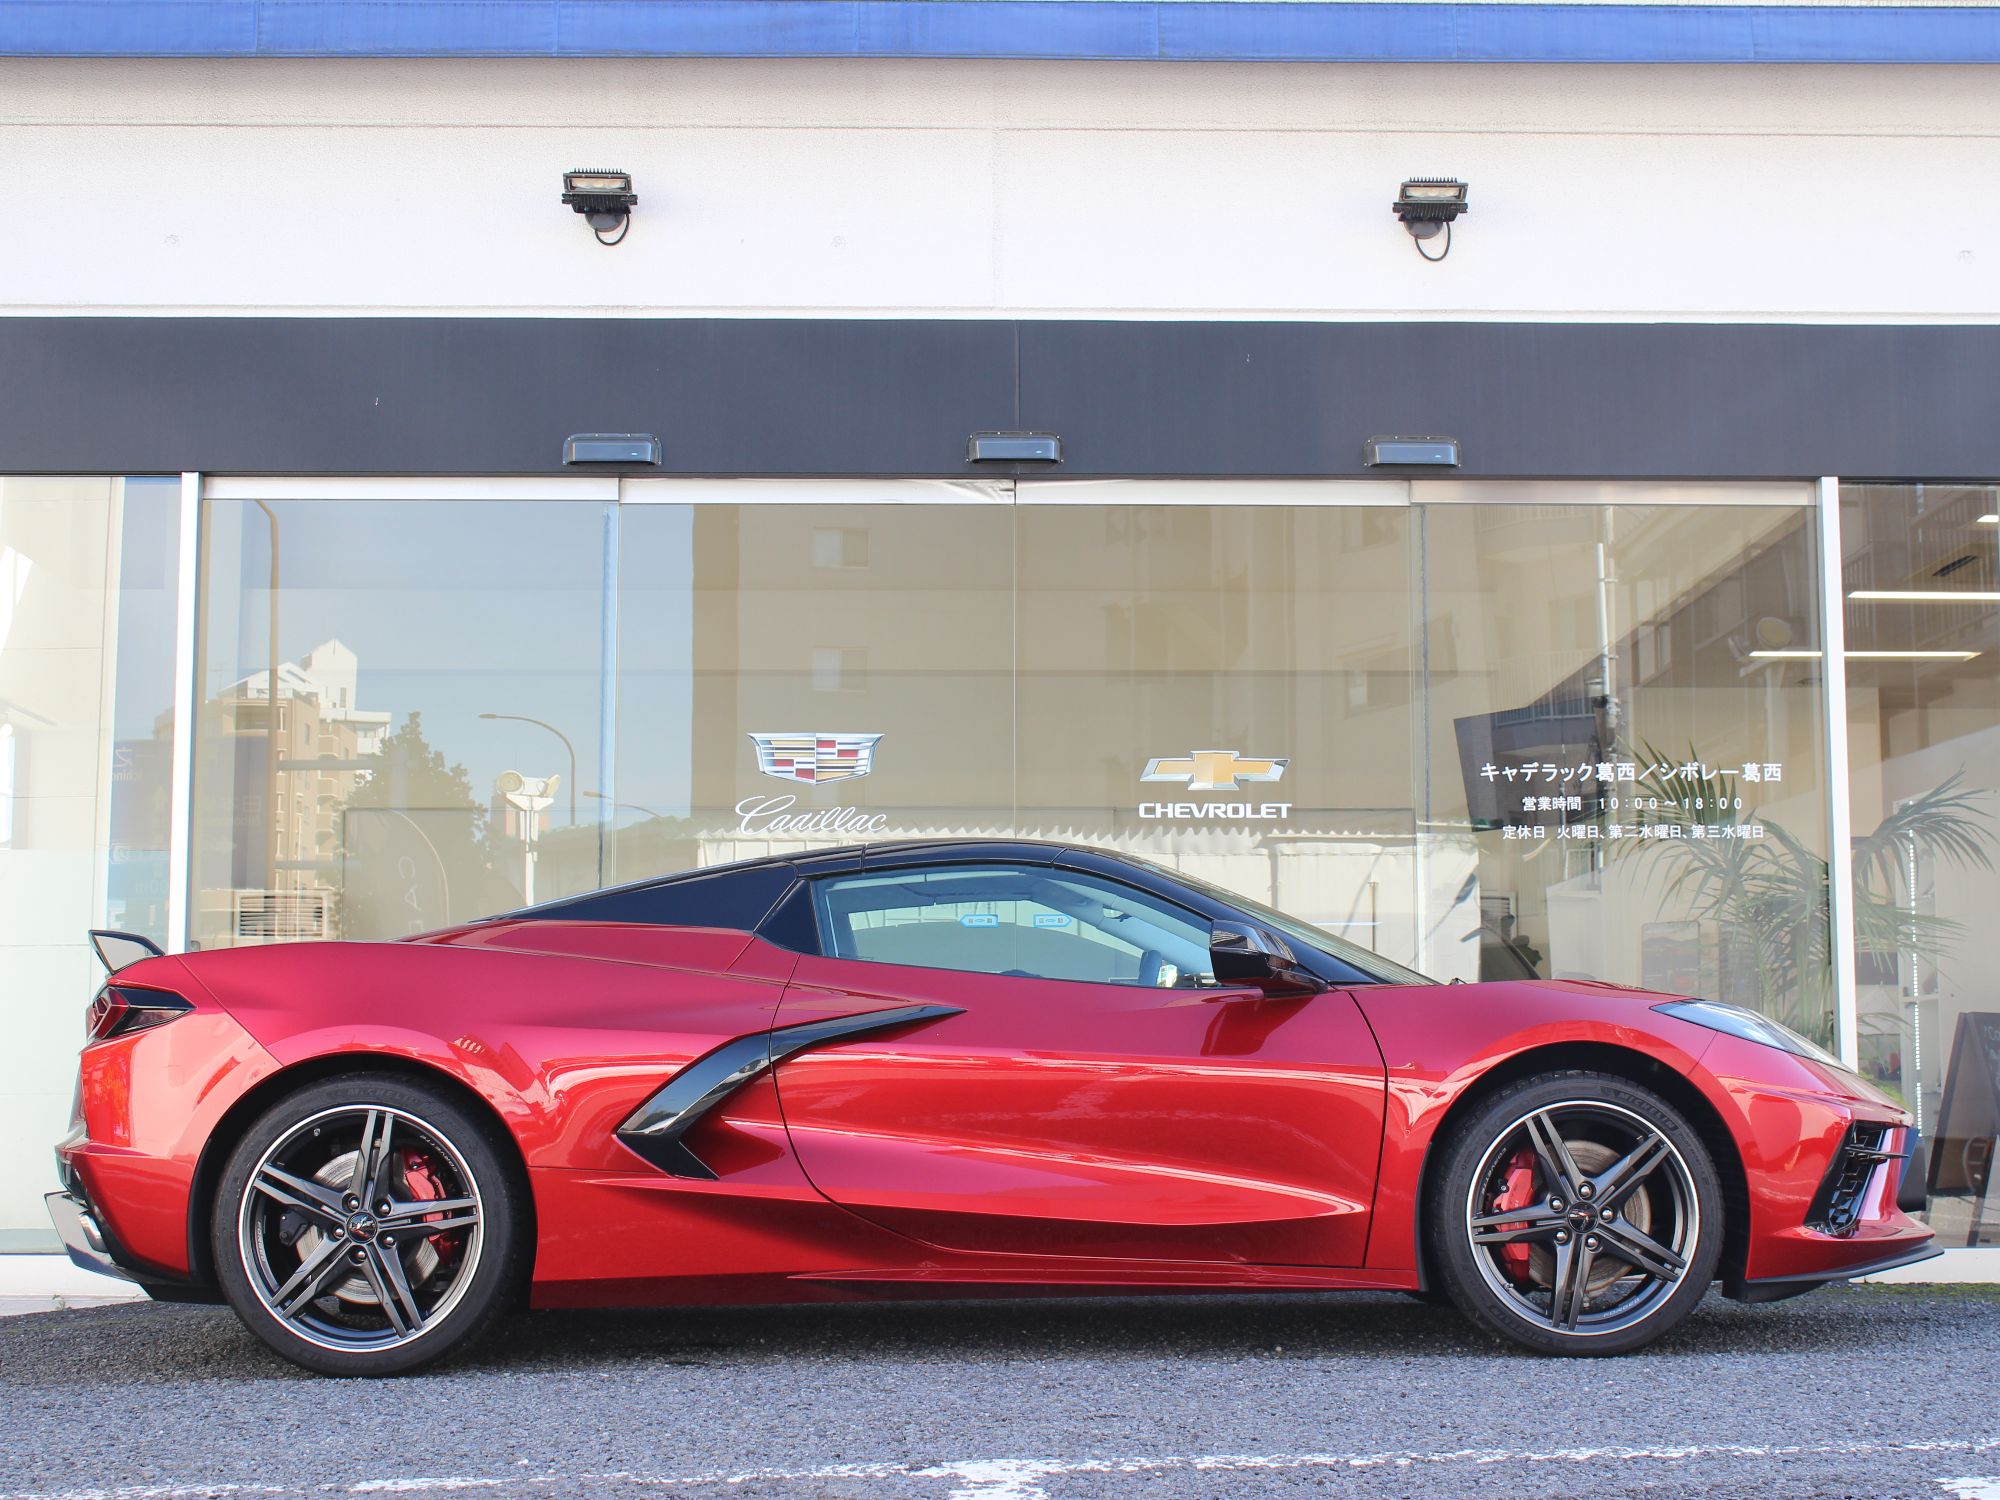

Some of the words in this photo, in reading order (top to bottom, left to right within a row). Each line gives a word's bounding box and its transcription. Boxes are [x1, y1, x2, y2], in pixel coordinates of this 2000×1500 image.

[1138, 803, 1292, 818] CHEVROLET
[1522, 796, 1582, 811] 営業時間
[735, 794, 887, 835] Cadillac
[1502, 825, 1545, 840] 定休日
[1618, 1091, 1676, 1129] MICHELIN
